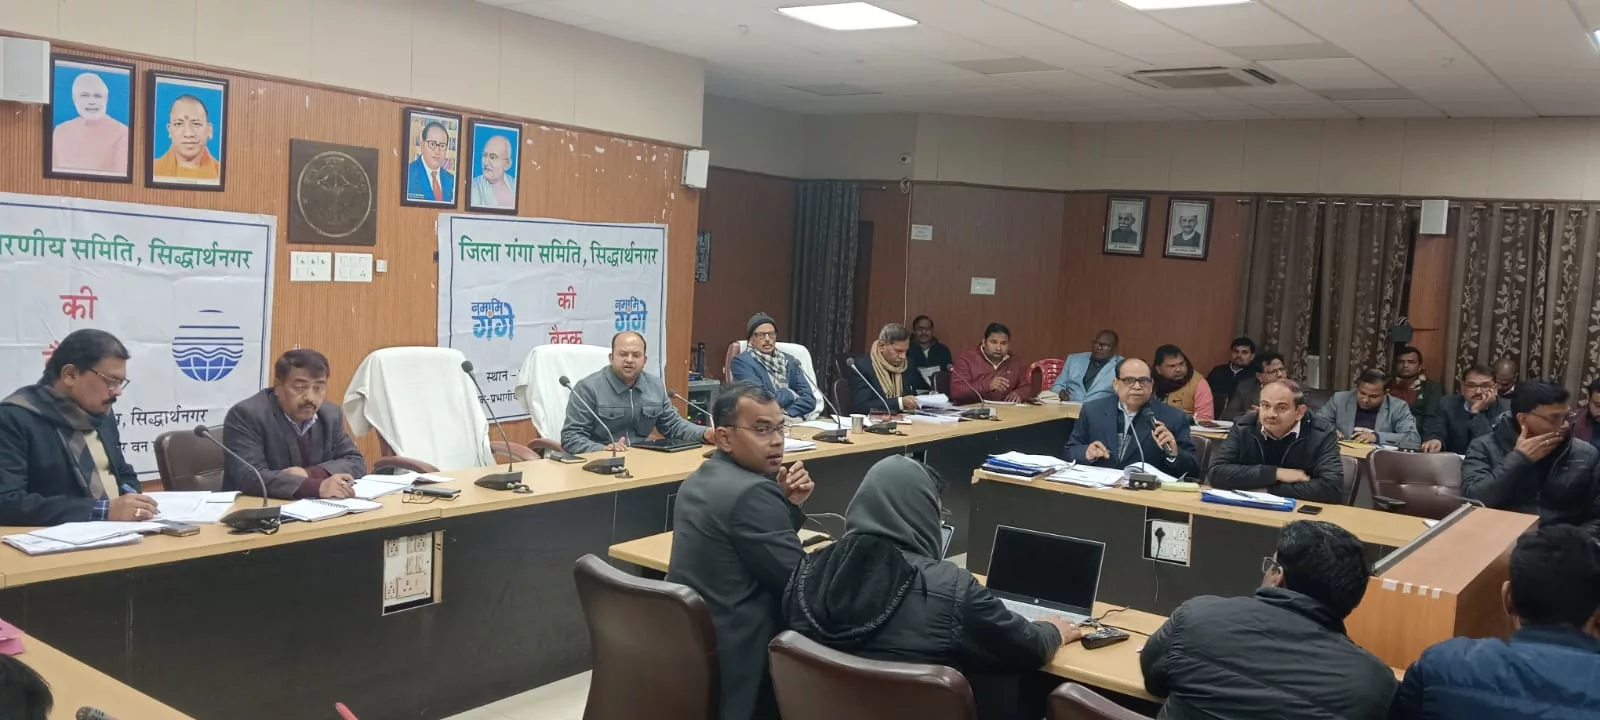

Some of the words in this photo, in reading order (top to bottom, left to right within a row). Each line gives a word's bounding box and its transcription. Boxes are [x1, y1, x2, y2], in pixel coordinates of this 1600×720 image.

[0, 228, 66, 258] रणीय
[70, 233, 142, 266] समिति,
[149, 238, 253, 269] सिद्धार्थनगर
[459, 235, 501, 263] जिला
[505, 238, 534, 263] गंगा
[538, 239, 587, 267] समिति,
[590, 240, 658, 267] सिद्धार्थनगर
[59, 285, 98, 320] की
[471, 298, 504, 315] नमामि
[557, 286, 576, 310] की
[614, 296, 639, 311] नमामि
[486, 371, 508, 382] स्थान
[130, 405, 208, 426] सिद्धार्थनगर
[130, 441, 149, 453] वन
